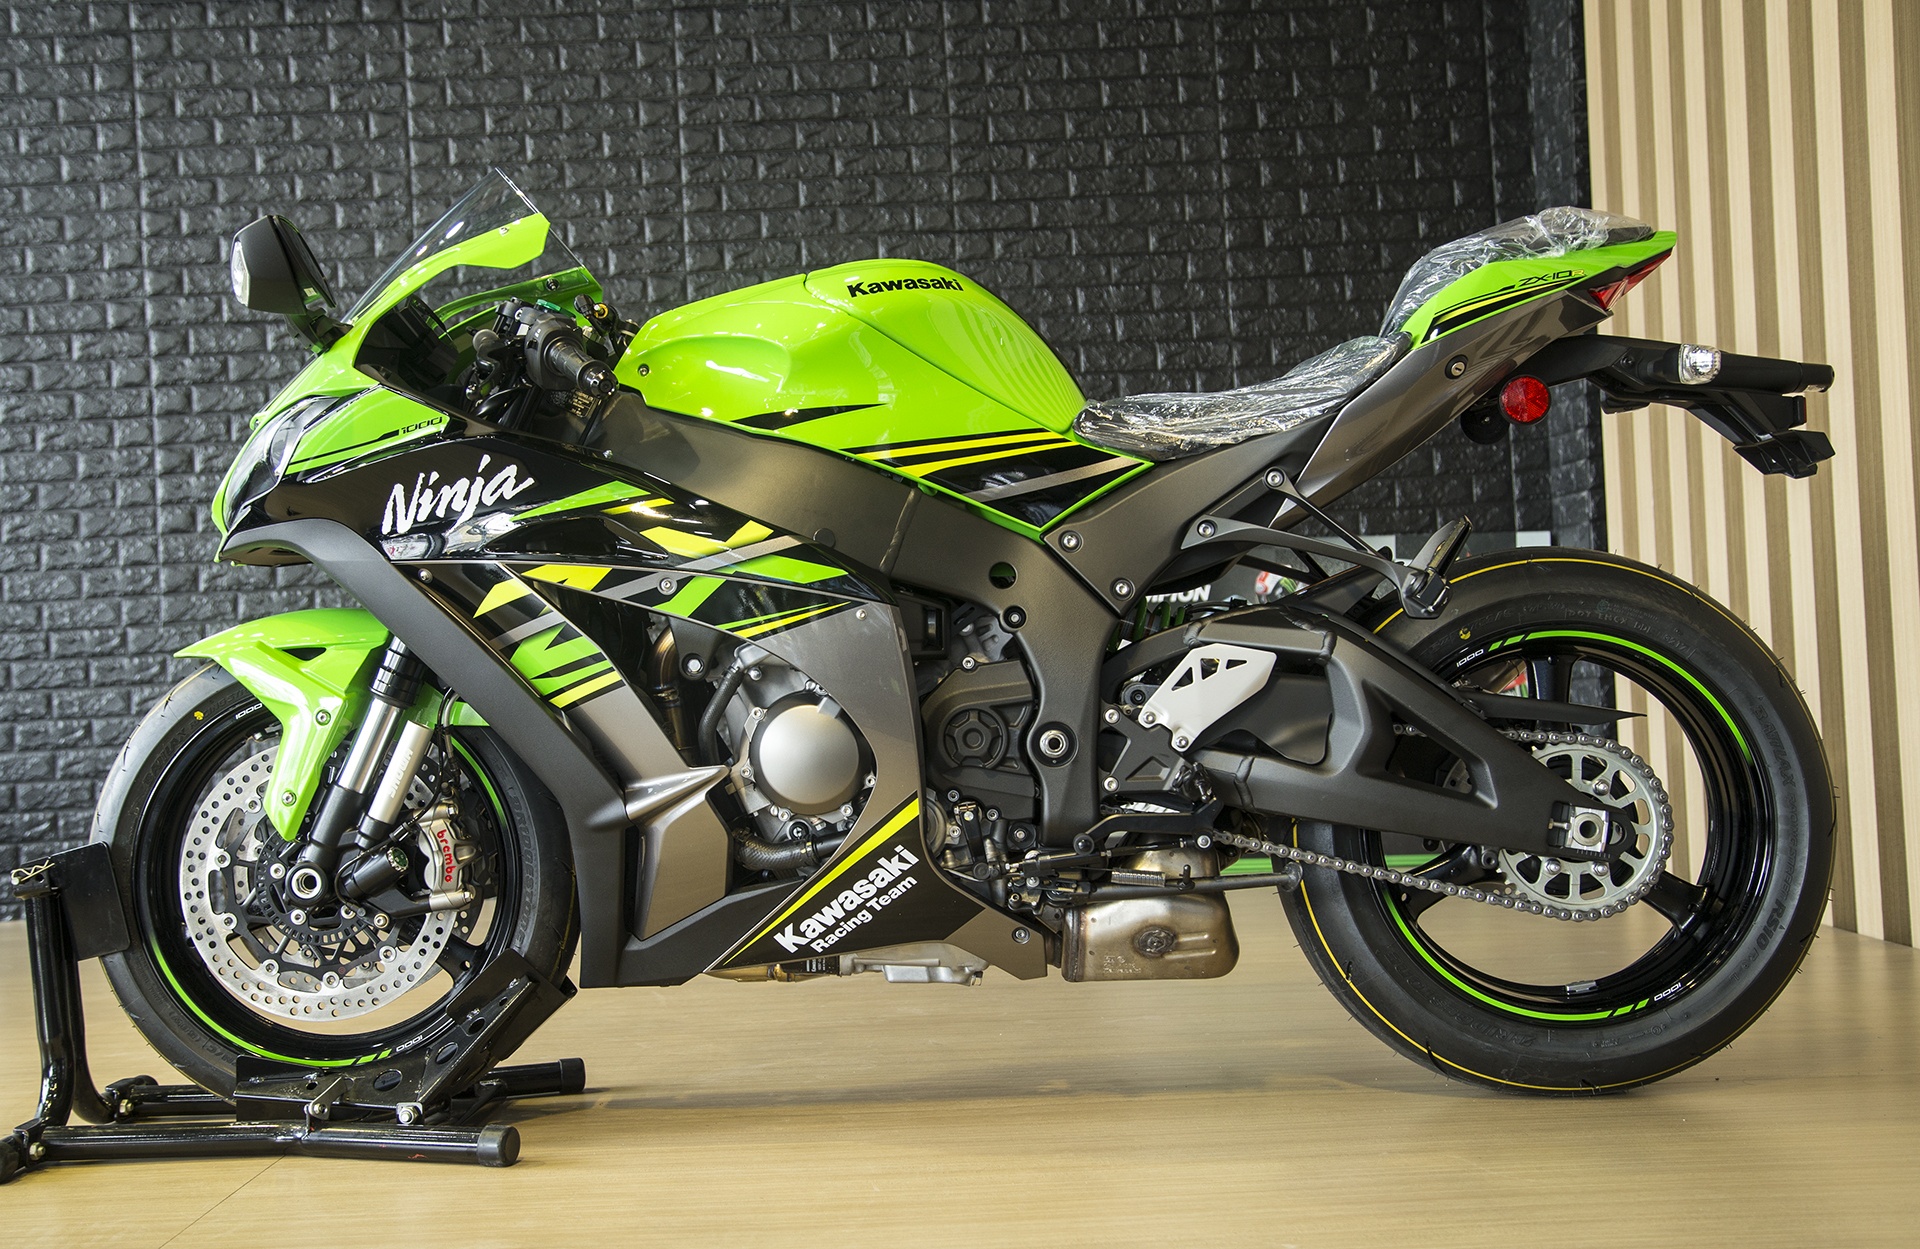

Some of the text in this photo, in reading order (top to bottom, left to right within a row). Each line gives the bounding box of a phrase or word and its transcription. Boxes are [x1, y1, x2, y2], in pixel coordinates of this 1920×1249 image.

[847, 277, 964, 298] Kawasaki
[1518, 269, 1586, 287] ZX-10R
[401, 416, 443, 434] 1000
[381, 454, 535, 535] Ninja
[1456, 648, 1484, 667] 1000
[235, 703, 263, 719] 1000
[437, 829, 457, 882] brembo
[773, 844, 919, 954] Kawasaki
[810, 876, 918, 953] Racing Team
[1752, 897, 1788, 952] RS10
[1654, 982, 1681, 1001] 1000
[396, 1035, 422, 1052] 1000
